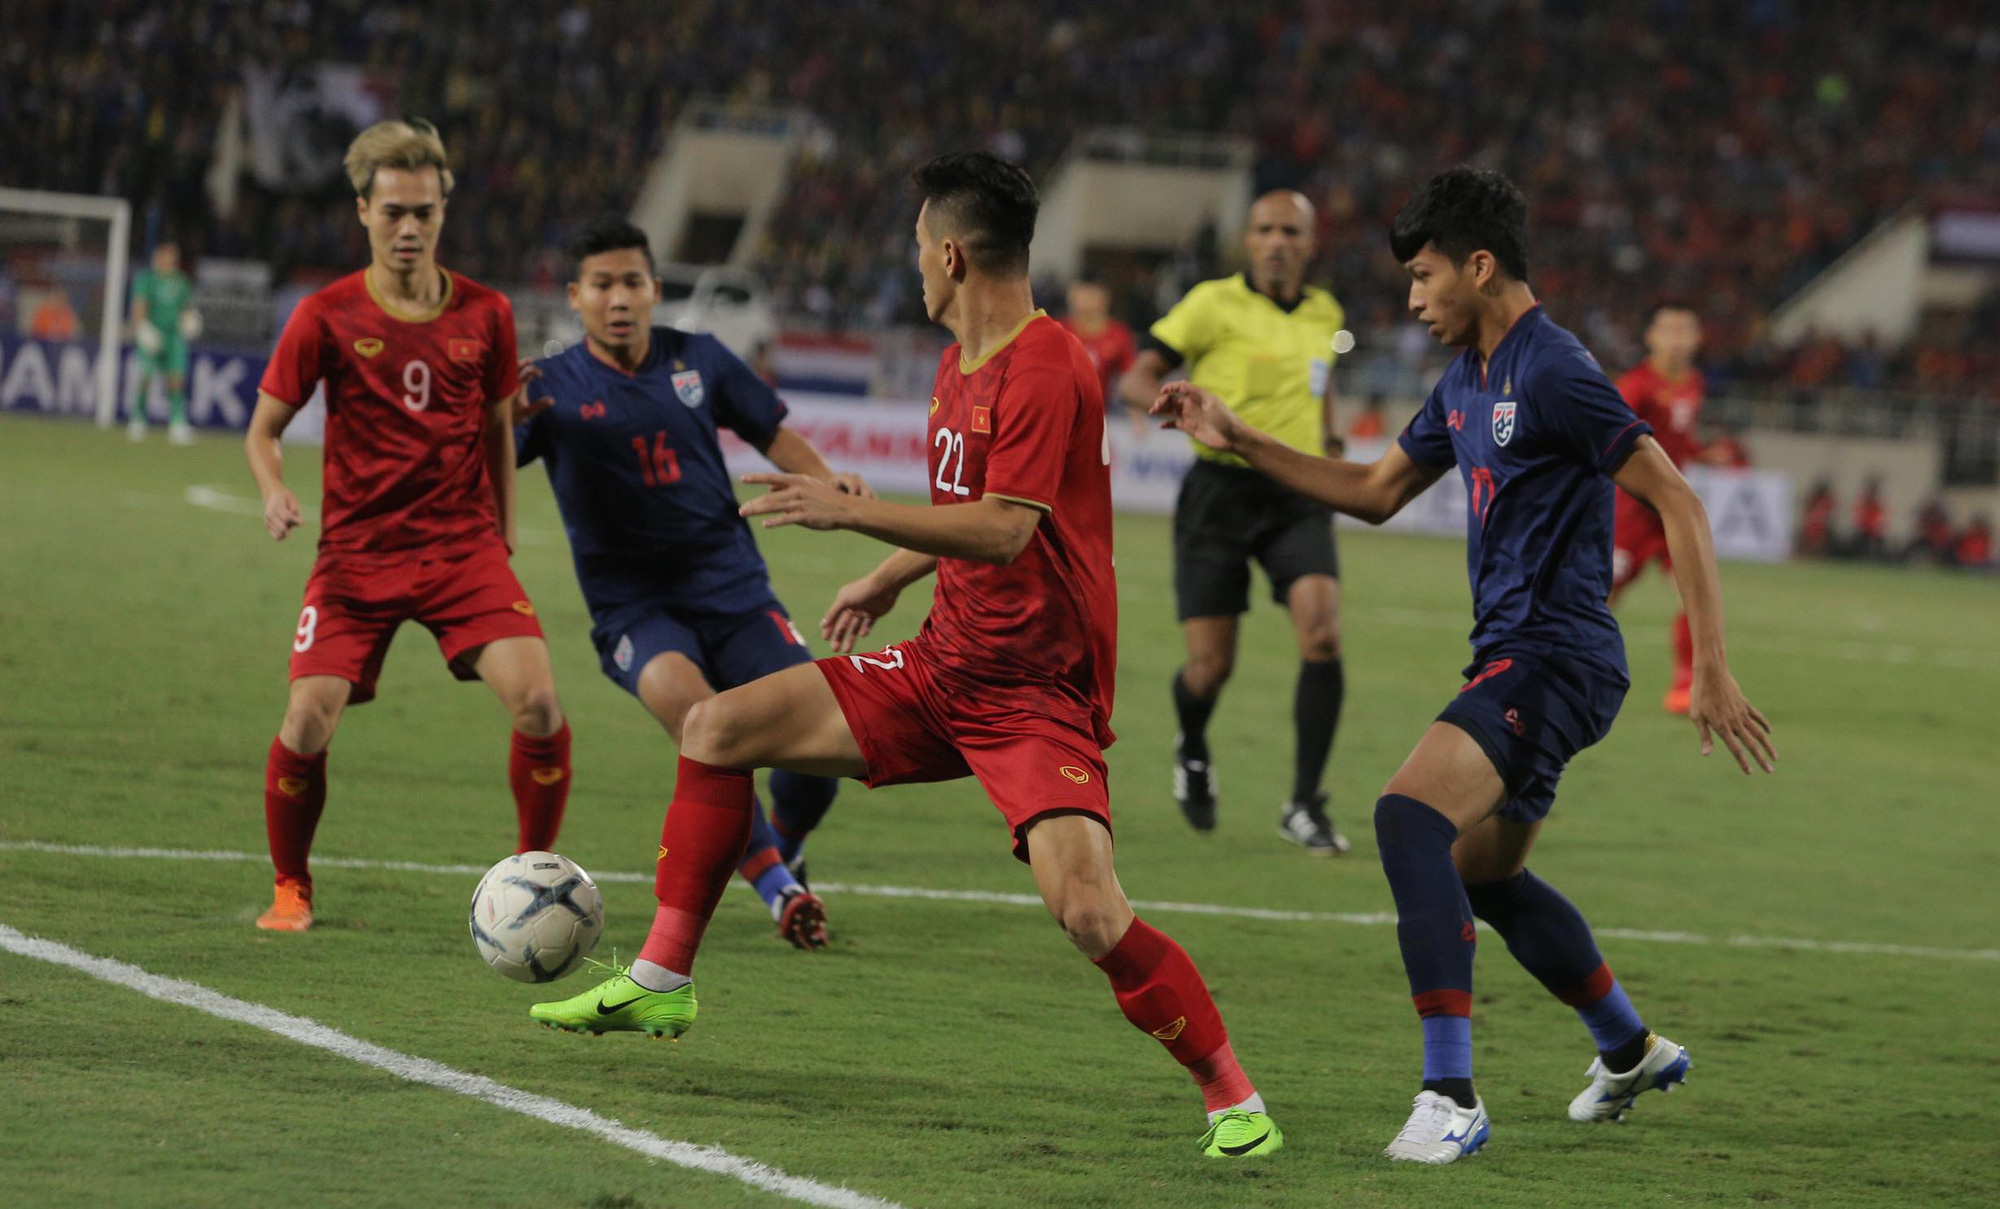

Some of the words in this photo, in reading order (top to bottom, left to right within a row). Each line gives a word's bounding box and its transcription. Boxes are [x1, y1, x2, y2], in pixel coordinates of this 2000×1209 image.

[403, 359, 430, 411] 9
[631, 430, 682, 486] 16
[935, 427, 969, 495] 22
[294, 605, 317, 652] 9
